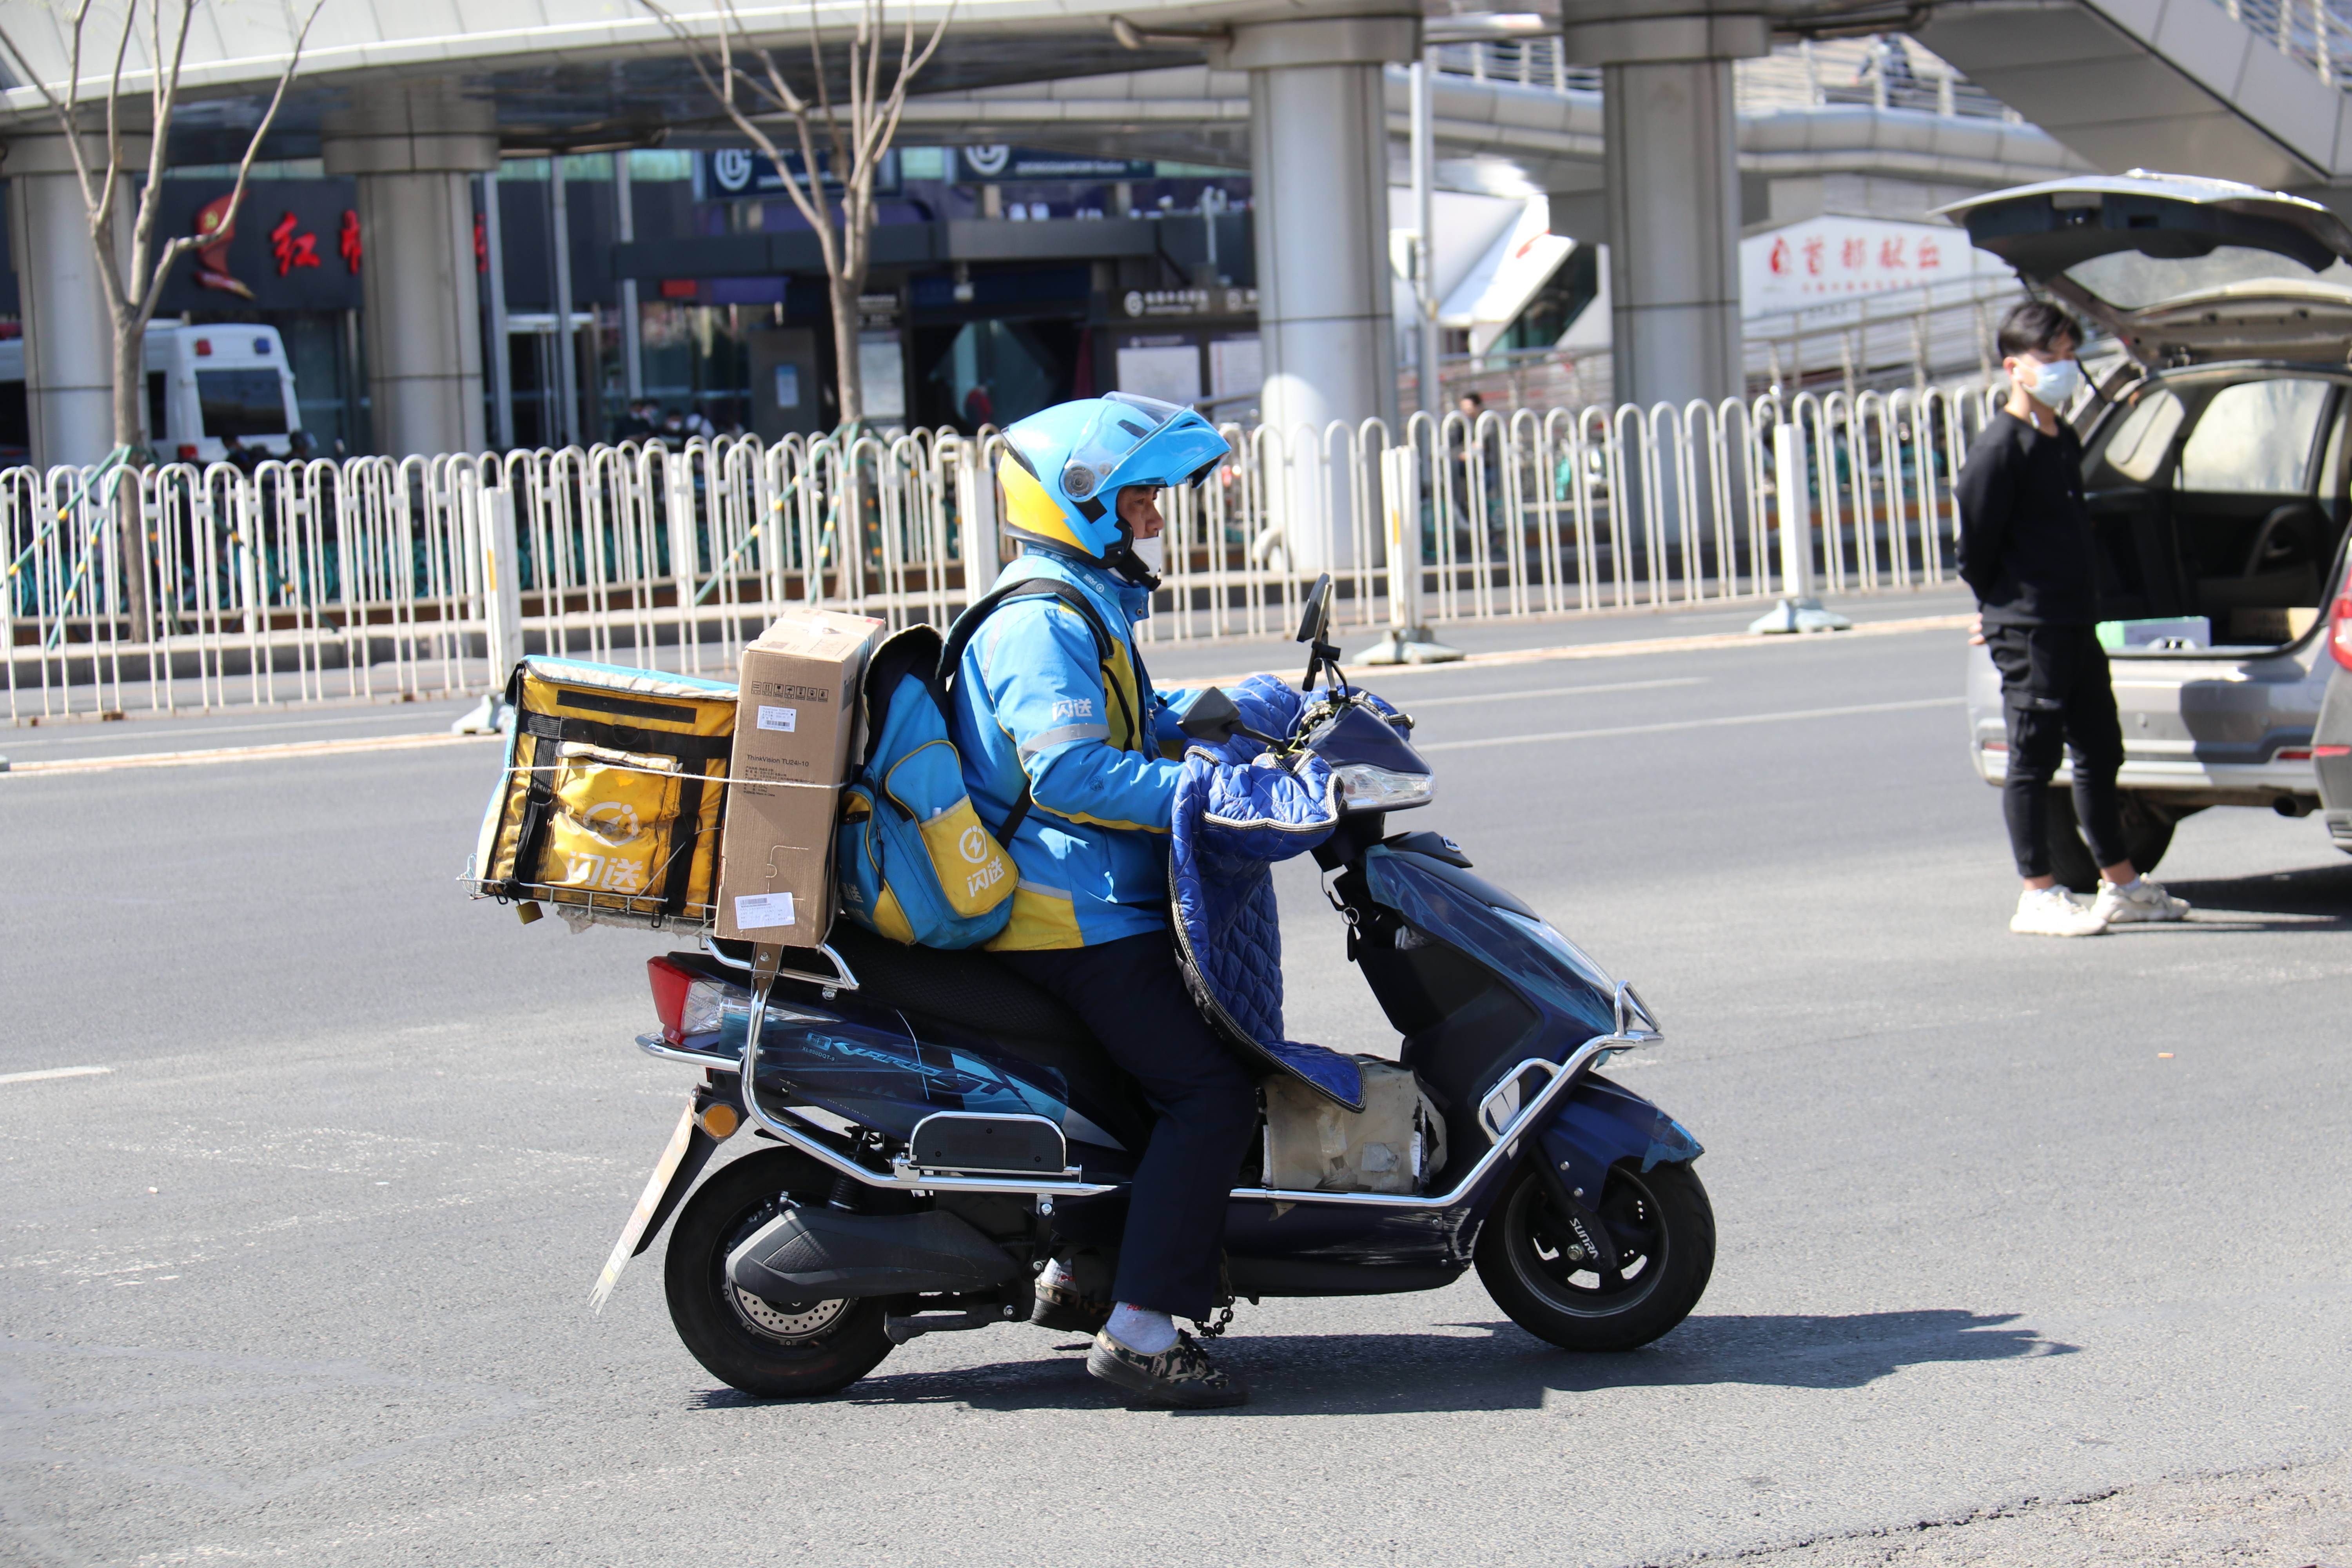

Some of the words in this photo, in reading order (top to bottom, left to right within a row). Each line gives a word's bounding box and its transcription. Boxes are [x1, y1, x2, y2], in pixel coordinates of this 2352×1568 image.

[1052, 698, 1092, 721] 闪送
[747, 755, 780, 764] ThinkVision
[565, 851, 643, 892] 闪送
[967, 855, 1005, 897] 闪送
